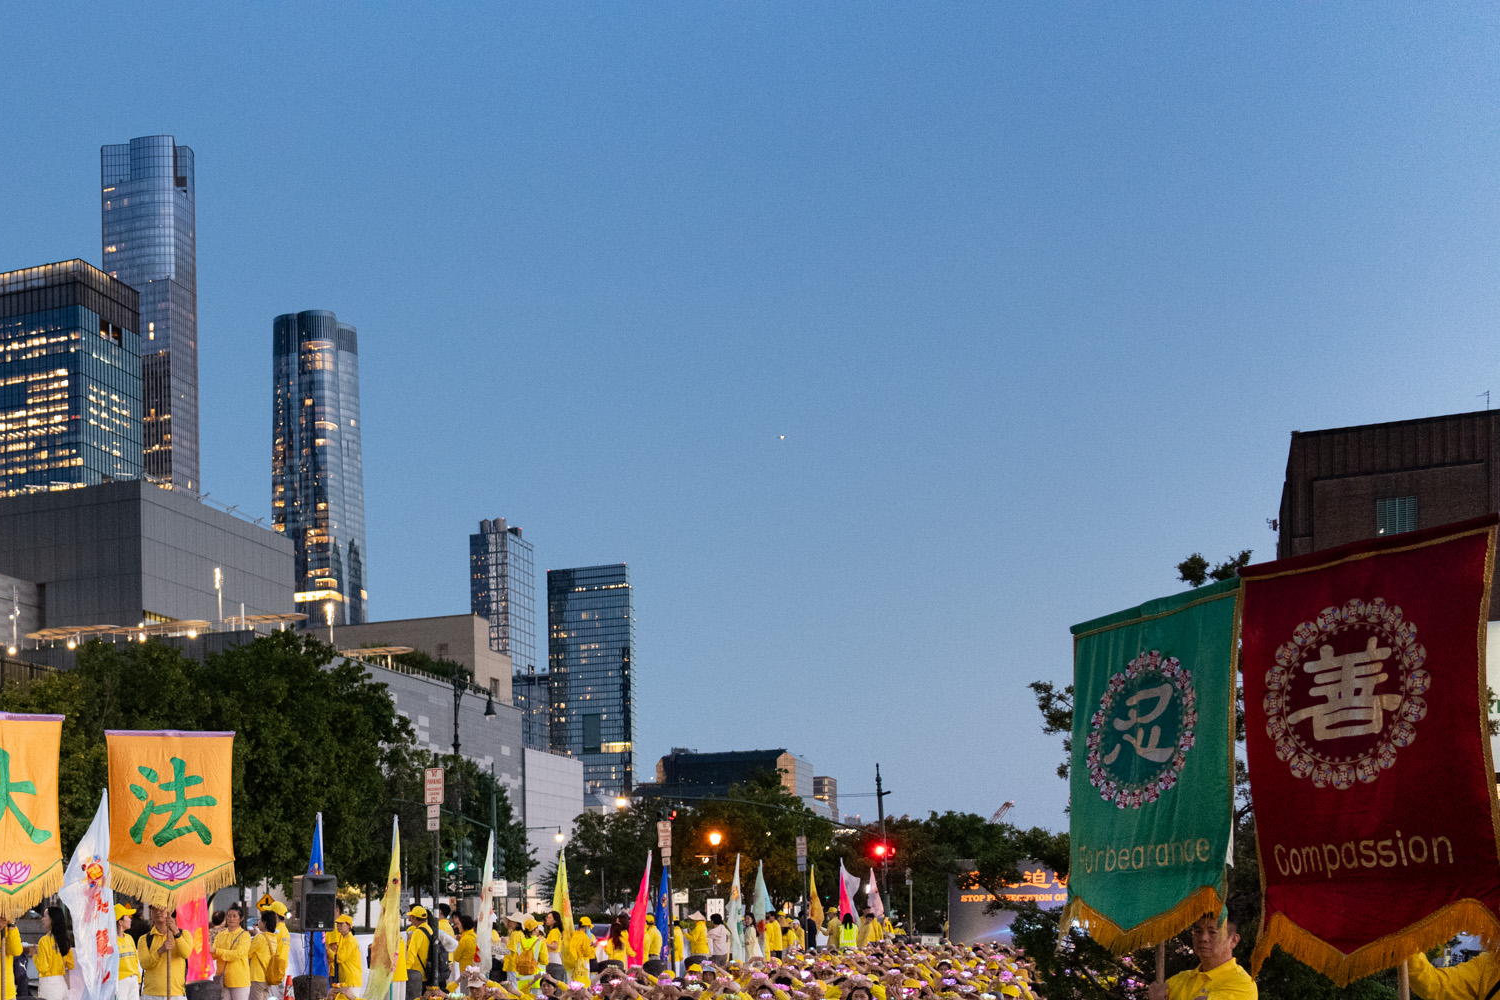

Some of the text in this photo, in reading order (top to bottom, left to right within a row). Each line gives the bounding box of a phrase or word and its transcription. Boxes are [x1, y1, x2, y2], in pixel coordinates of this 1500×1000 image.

[1286, 636, 1404, 742] 善
[129, 756, 218, 848] 法
[1078, 835, 1212, 874] Forbearance
[1273, 829, 1454, 880] Compassion
[960, 894, 986, 903] STOP
[986, 893, 1053, 903] PSECUTION
